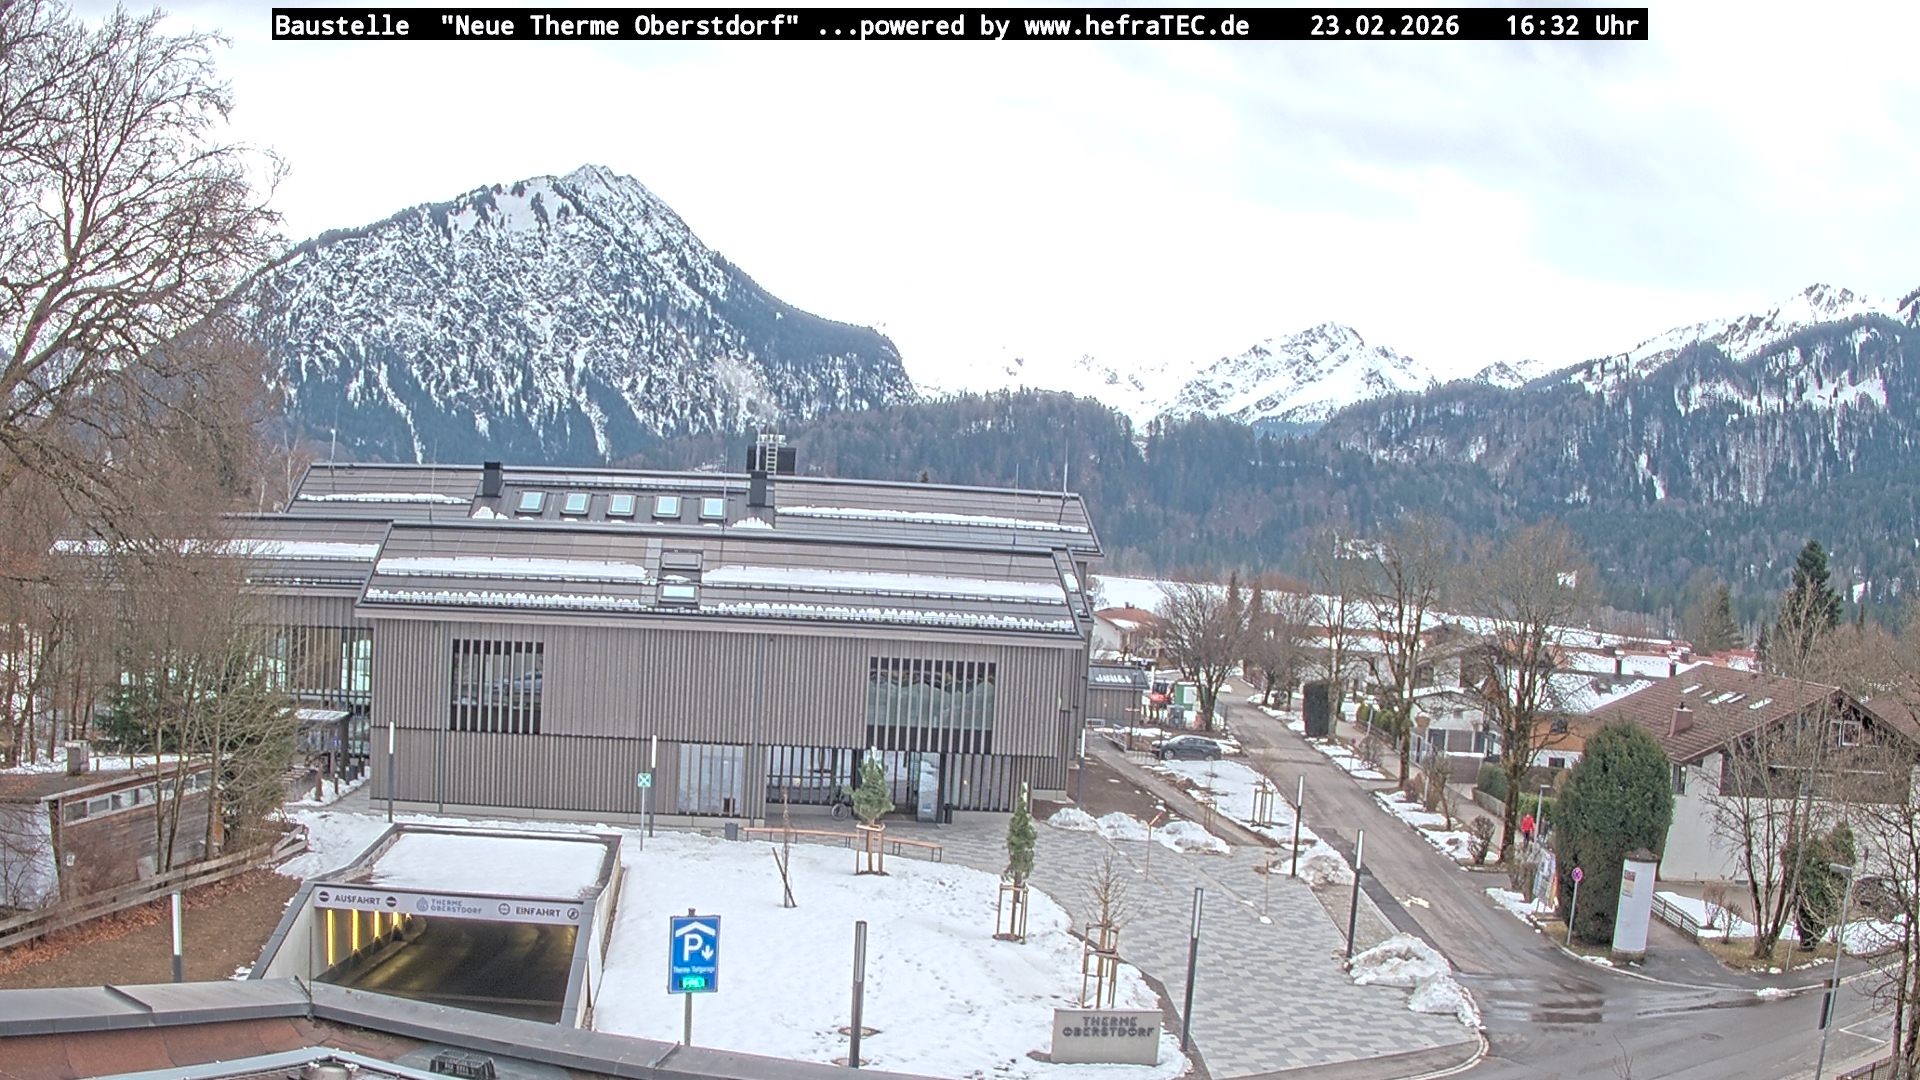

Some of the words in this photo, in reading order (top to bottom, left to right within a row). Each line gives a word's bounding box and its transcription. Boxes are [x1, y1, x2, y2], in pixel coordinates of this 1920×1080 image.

[334, 894, 380, 905] AUSFAHRT
[431, 899, 463, 908] THERME
[430, 904, 483, 915] OBERSTDORF
[515, 906, 561, 917] EINFAHRT
[683, 934, 703, 962] P
[1082, 1016, 1138, 1027] THERME
[1062, 1026, 1155, 1038] OBERSTDORF
